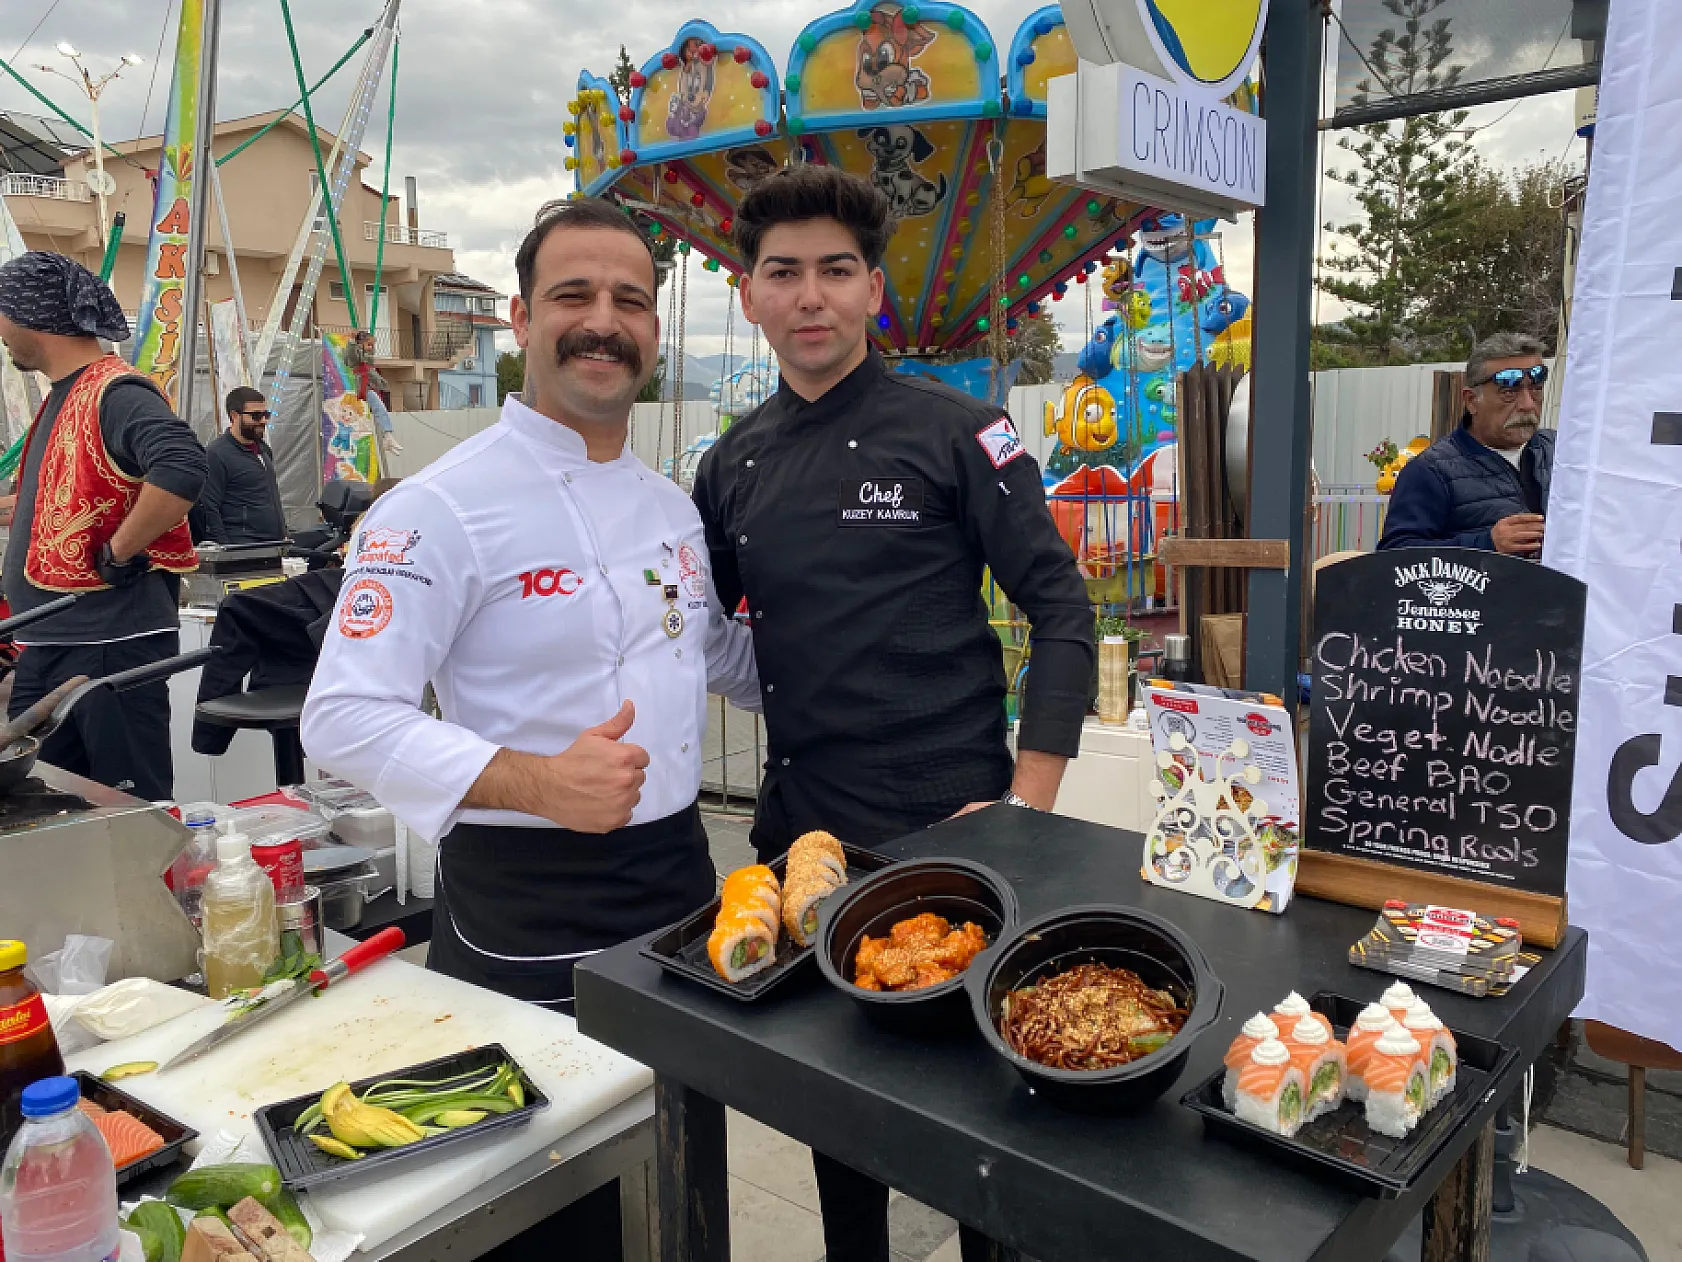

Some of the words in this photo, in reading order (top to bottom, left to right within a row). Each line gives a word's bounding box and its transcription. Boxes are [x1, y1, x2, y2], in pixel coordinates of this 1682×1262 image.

[1133, 80, 1257, 194] CRIMSON
[151, 196, 191, 404] AKSİY
[842, 509, 873, 520] KUZEY
[859, 482, 904, 508] Chef
[1395, 563, 1430, 588] JACK
[1431, 557, 1491, 594] DANIEL'S
[1397, 617, 1484, 635] HONEY
[1398, 599, 1481, 621] Tennessee
[1317, 631, 1447, 678] Chicken
[1464, 643, 1573, 694] Noodle
[1320, 672, 1454, 722] Shrimp
[1464, 688, 1577, 733] Noodle
[1326, 741, 1408, 781] Beef
[1427, 759, 1512, 796] BAO
[1462, 730, 1561, 767] Nodle
[1323, 778, 1456, 821] General
[1470, 801, 1558, 832] TSO
[1318, 806, 1451, 862] Spring
